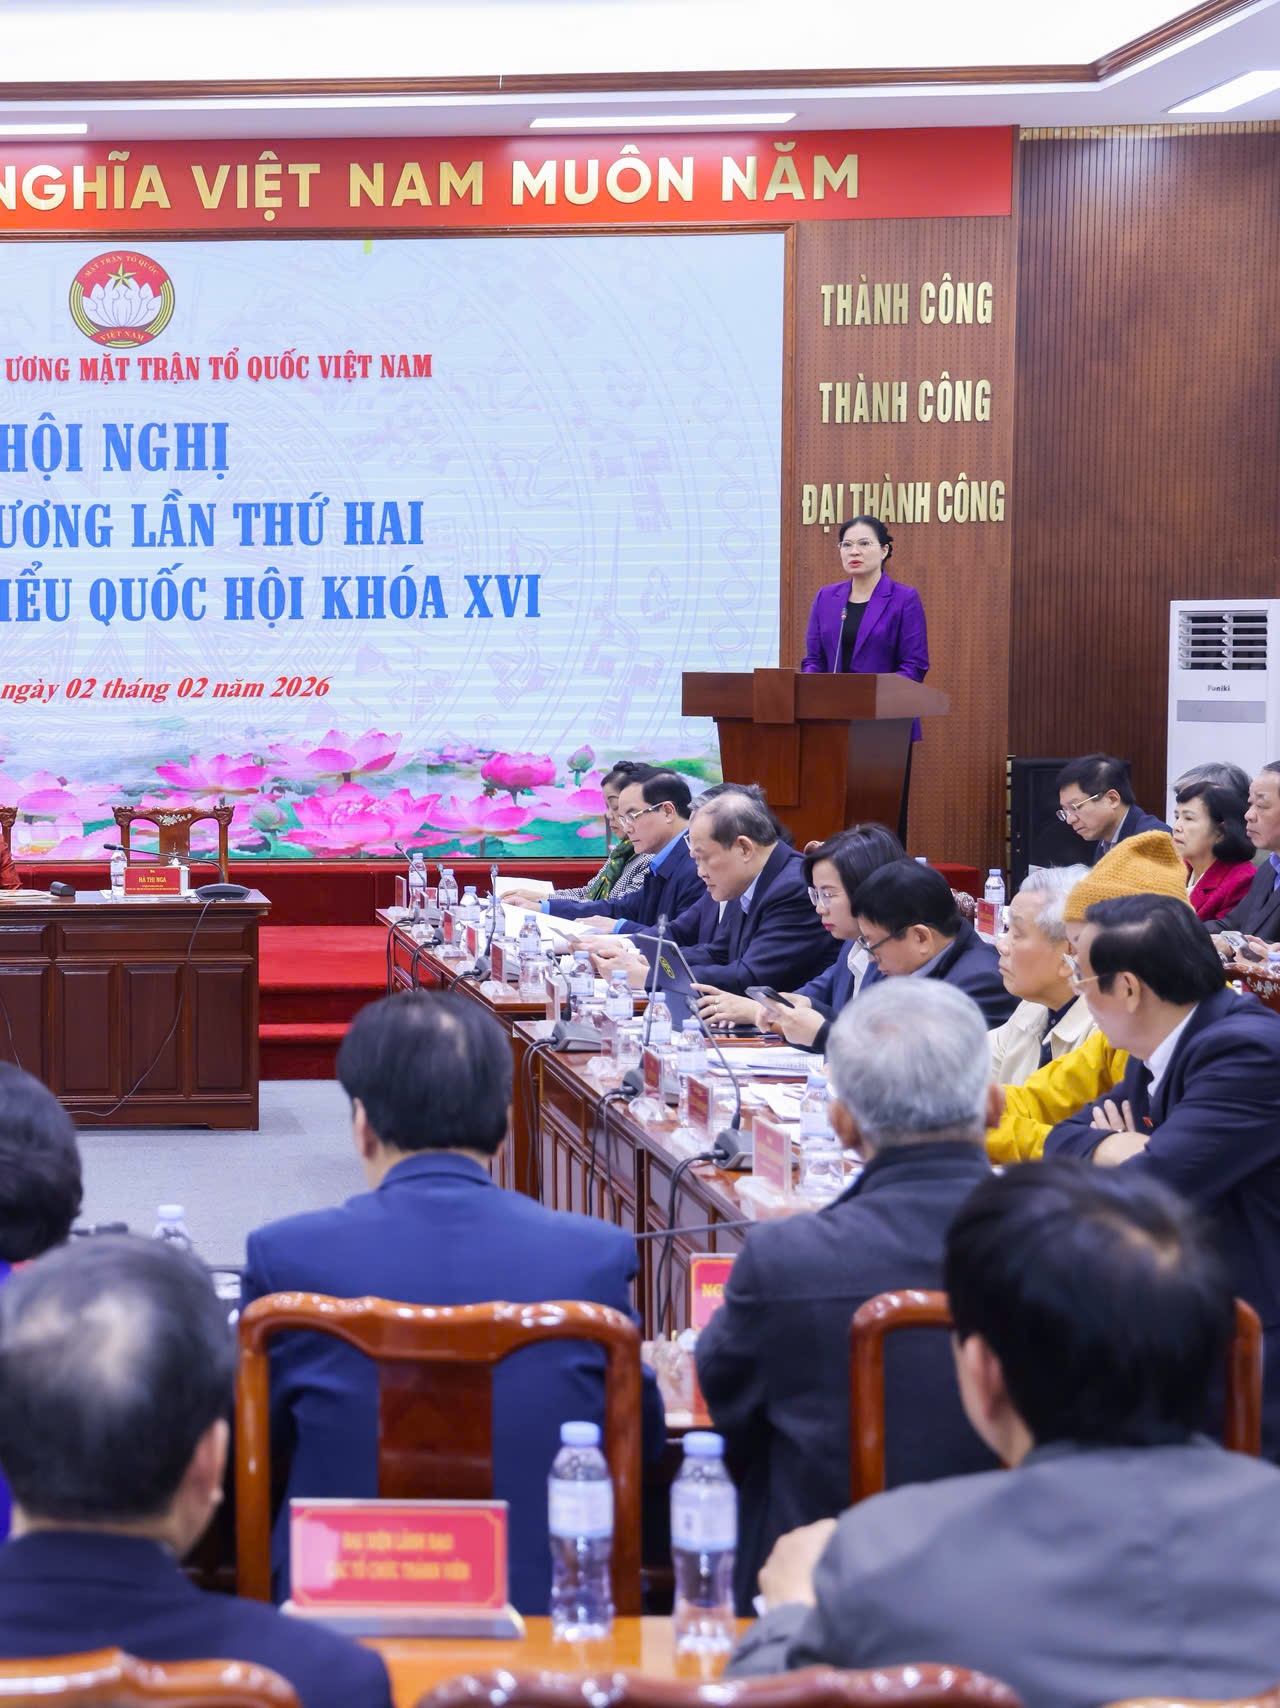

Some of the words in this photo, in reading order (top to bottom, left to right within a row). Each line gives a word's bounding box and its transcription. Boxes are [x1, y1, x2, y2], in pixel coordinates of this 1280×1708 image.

[191, 150, 320, 221] VIỆT
[350, 161, 483, 207] NAM
[512, 144, 694, 205] MUÔN
[722, 141, 858, 200] NĂM
[821, 273, 908, 326] THÀNH
[920, 272, 993, 325] CÔNG
[125, 331, 145, 341] NAM
[5, 356, 69, 382] ƯƠNG
[79, 353, 130, 385] MẶT
[138, 352, 201, 384] TRẬN
[209, 347, 239, 381] TỔ
[247, 348, 309, 382] QUỐC
[318, 350, 372, 383] VIỆT
[380, 354, 432, 378] NAM
[819, 372, 907, 424] THÀNH
[918, 371, 991, 423] CÔNG
[103, 422, 229, 480] NGHỊ
[131, 488, 216, 547] LẦN
[233, 491, 330, 546] THỨ
[344, 501, 424, 545] HAI
[802, 483, 844, 533] ĐẠI
[850, 473, 931, 523] THÀNH
[938, 472, 1005, 523] CÔNG
[89, 562, 207, 626] QUỐC
[223, 566, 304, 629] HỘI
[321, 564, 448, 620] KHÓA
[464, 574, 541, 618] XVI
[0, 678, 60, 704] ngày
[65, 678, 97, 699] 02
[102, 677, 171, 703] tháng
[177, 677, 208, 698] 02
[211, 678, 265, 698] năm
[269, 676, 334, 697] 2026
